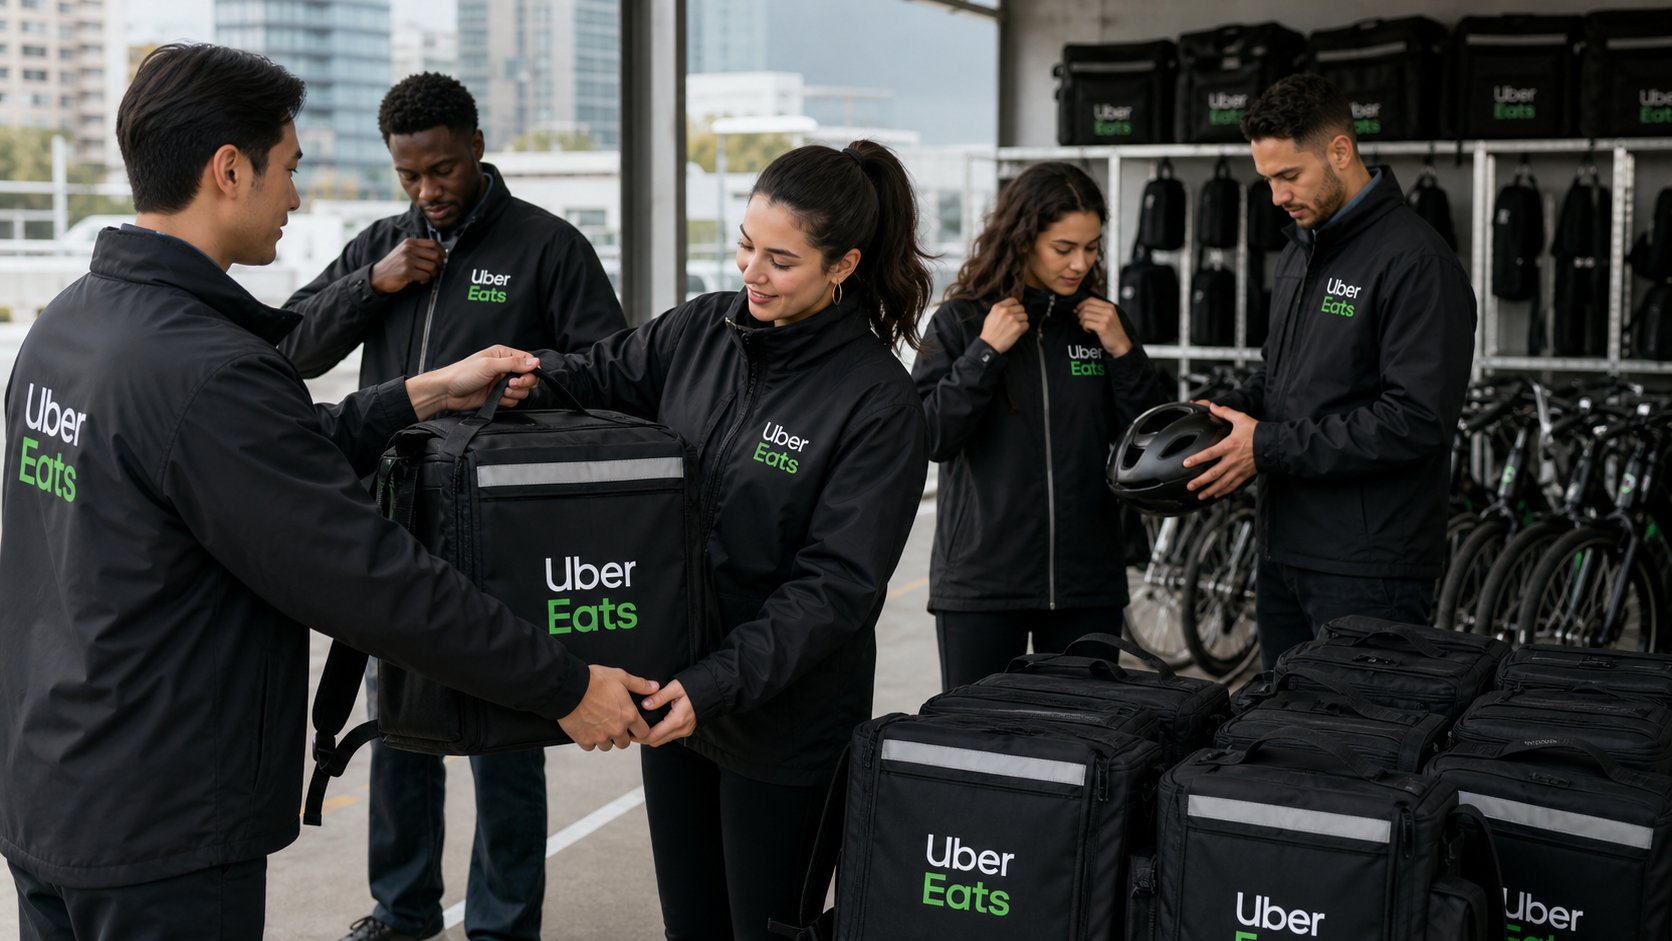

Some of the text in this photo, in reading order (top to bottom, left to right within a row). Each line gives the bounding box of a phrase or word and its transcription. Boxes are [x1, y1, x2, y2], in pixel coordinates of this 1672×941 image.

[1208, 92, 1248, 110] Uber
[1494, 85, 1537, 103] Uber
[1640, 88, 1672, 107] Ube
[1094, 103, 1132, 121] Uber
[1349, 101, 1381, 119] ber
[1494, 102, 1536, 120] Eats
[1640, 106, 1672, 123] Eat
[1094, 120, 1132, 136] Eats
[1354, 119, 1381, 135] ats
[472, 268, 511, 287] Uber
[467, 285, 507, 303] Eats
[1326, 278, 1362, 299] Uber
[1321, 295, 1355, 317] Eats
[1067, 345, 1103, 359] Uber
[1071, 360, 1105, 376] Eats
[25, 382, 87, 447] Uber
[763, 421, 810, 453] Uber
[753, 442, 799, 475] Eats
[19, 436, 77, 502] Eats
[545, 556, 636, 592] Uber
[547, 597, 638, 635] Eats
[926, 833, 1015, 877] Uber
[922, 871, 1010, 916] Eats
[1236, 891, 1326, 937] Uber
[1503, 887, 1584, 932] Uber
